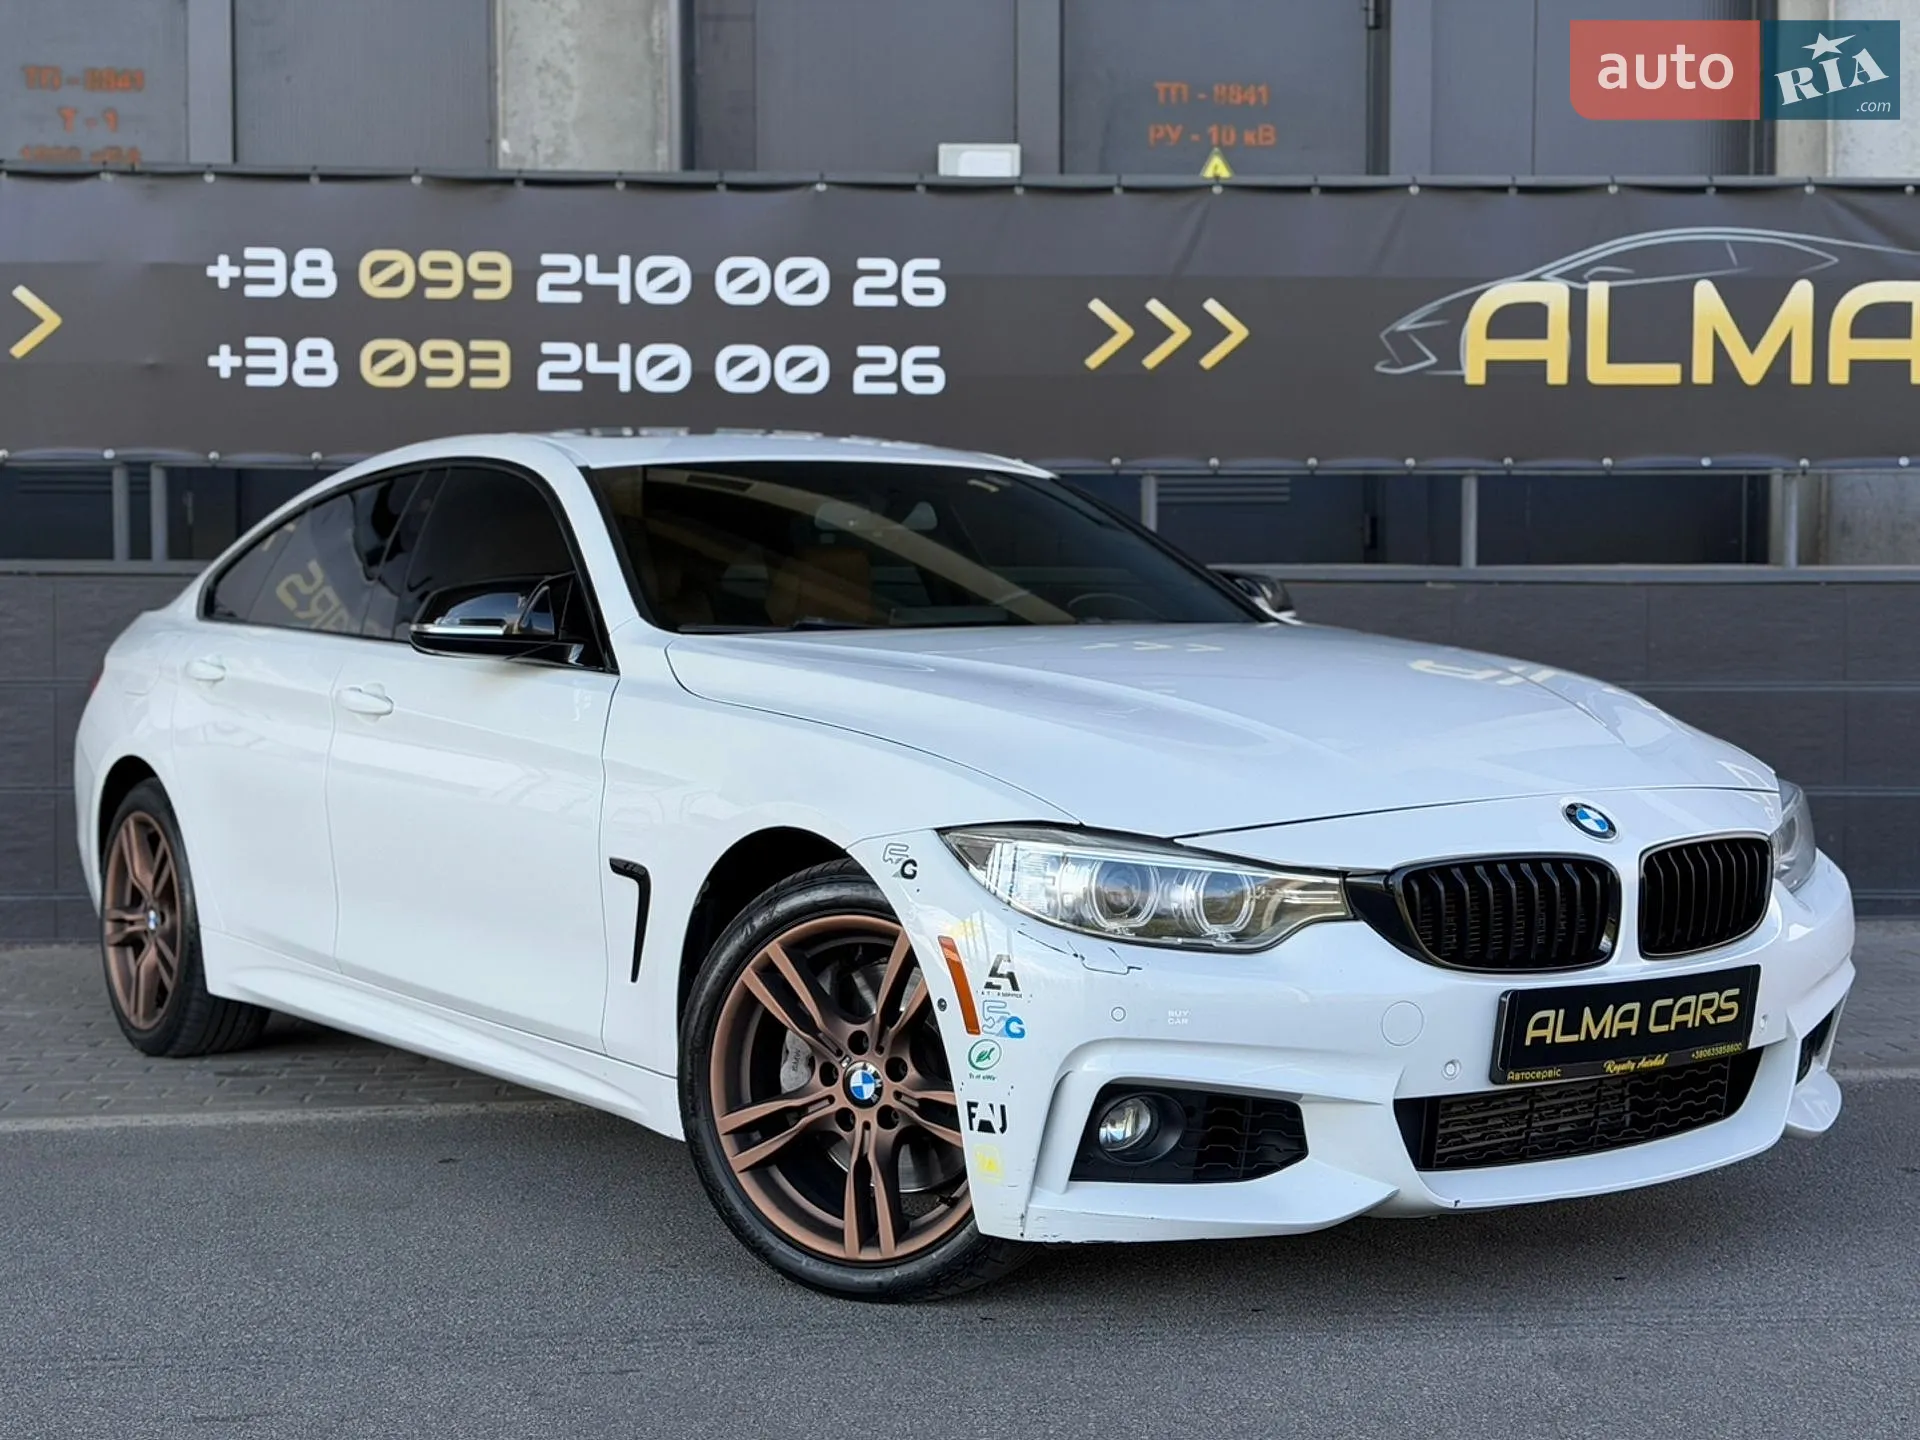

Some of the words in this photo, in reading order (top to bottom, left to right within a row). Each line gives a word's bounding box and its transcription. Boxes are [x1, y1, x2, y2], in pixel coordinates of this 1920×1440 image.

[206, 247, 337, 298] +38
[359, 250, 512, 300] 099
[537, 253, 692, 305] 240
[715, 256, 830, 306] 00
[853, 257, 946, 308] 26
[1464, 279, 1920, 385] ALMA
[207, 337, 339, 387] +38
[360, 339, 512, 389] 093
[537, 342, 692, 393] 240
[715, 344, 830, 394] 00
[853, 345, 946, 395] 26
[1524, 1002, 1641, 1046] ALMA
[1648, 988, 1740, 1033] CARS
